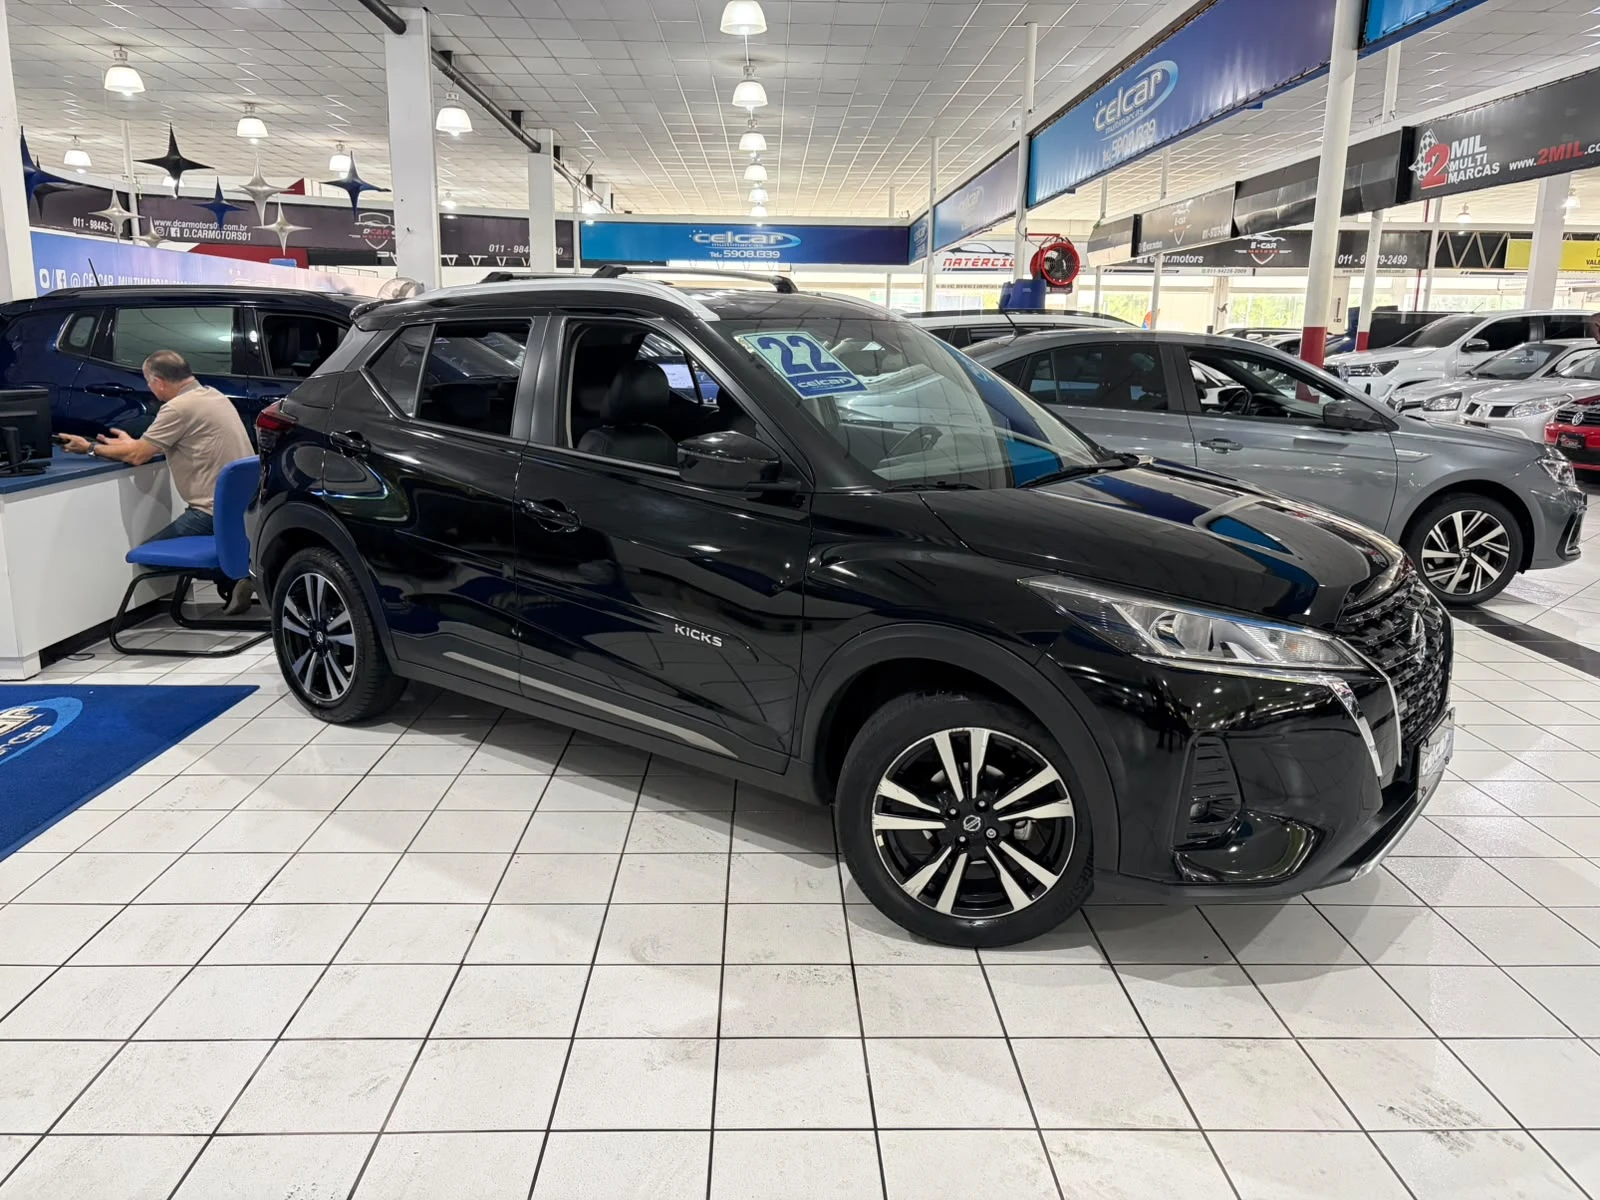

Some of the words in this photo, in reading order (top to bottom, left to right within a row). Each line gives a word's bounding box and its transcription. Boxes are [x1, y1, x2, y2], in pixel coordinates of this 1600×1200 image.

[1095, 69, 1163, 132] celcar
[1420, 143, 1450, 189] 2
[1451, 135, 1487, 159] MIL
[1449, 153, 1487, 171] MULTI
[1447, 162, 1500, 184] MARCAS
[72, 217, 84, 227] 011
[153, 219, 248, 231] www.dcarmotors0com.br
[183, 228, 252, 241] D.CARMOTORS01
[692, 231, 784, 244] celcar
[1337, 254, 1353, 265] 011
[1359, 254, 1408, 265] 99-2499
[757, 335, 844, 375] 22
[797, 377, 848, 388] celcar
[674, 623, 723, 647] KICKS
